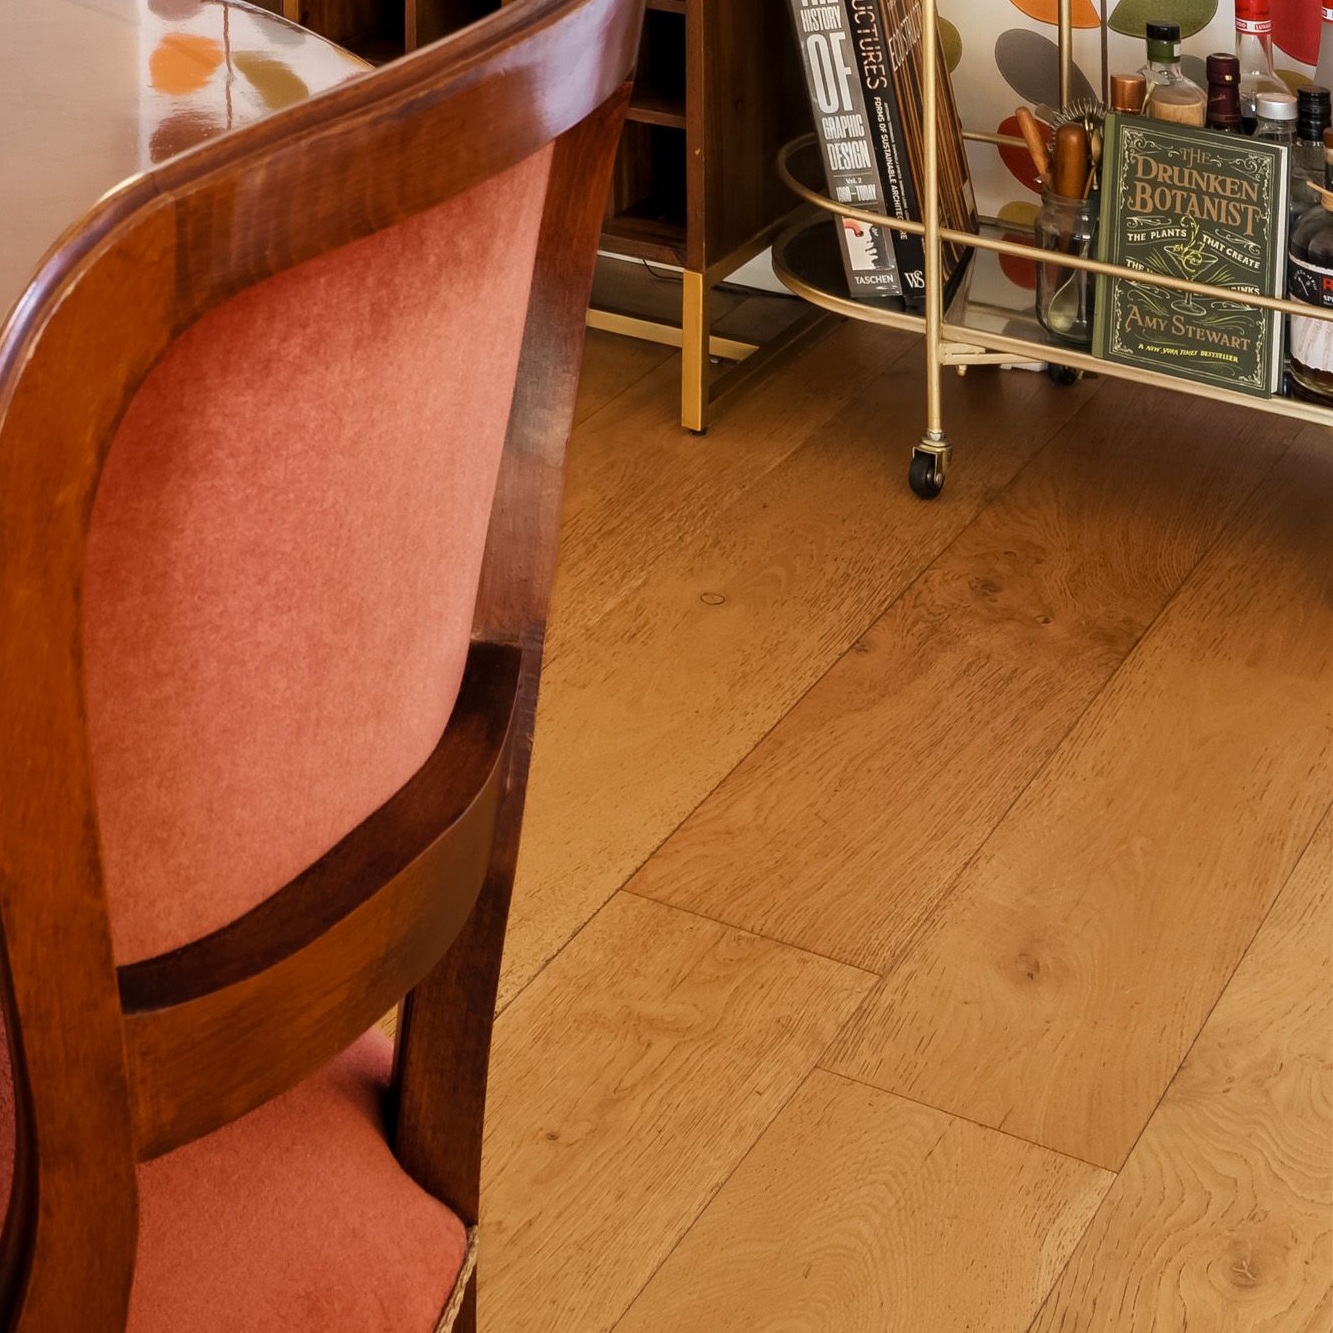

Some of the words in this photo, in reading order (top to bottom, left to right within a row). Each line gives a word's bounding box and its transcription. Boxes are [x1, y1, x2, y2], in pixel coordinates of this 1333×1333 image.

[800, 5, 842, 32] HISTORY
[806, 31, 854, 113] OF
[874, 96, 885, 122] FORMS
[822, 114, 865, 140] GRAPHIC
[879, 123, 887, 133] OF
[826, 140, 872, 171] DESIGN
[881, 134, 897, 184] SUSTAINABLE
[1179, 148, 1212, 167] THE
[1131, 154, 1259, 202] DRUNKEN
[1127, 181, 1263, 236] BOTANIST
[1127, 233, 1146, 241] THE
[1150, 229, 1187, 240] PLANTS
[1202, 234, 1225, 251] THAT
[1226, 248, 1261, 269] CREATE
[854, 274, 894, 284] TASCHEN
[1162, 347, 1178, 356] YORK
[1200, 350, 1239, 363] BESTSELLER
